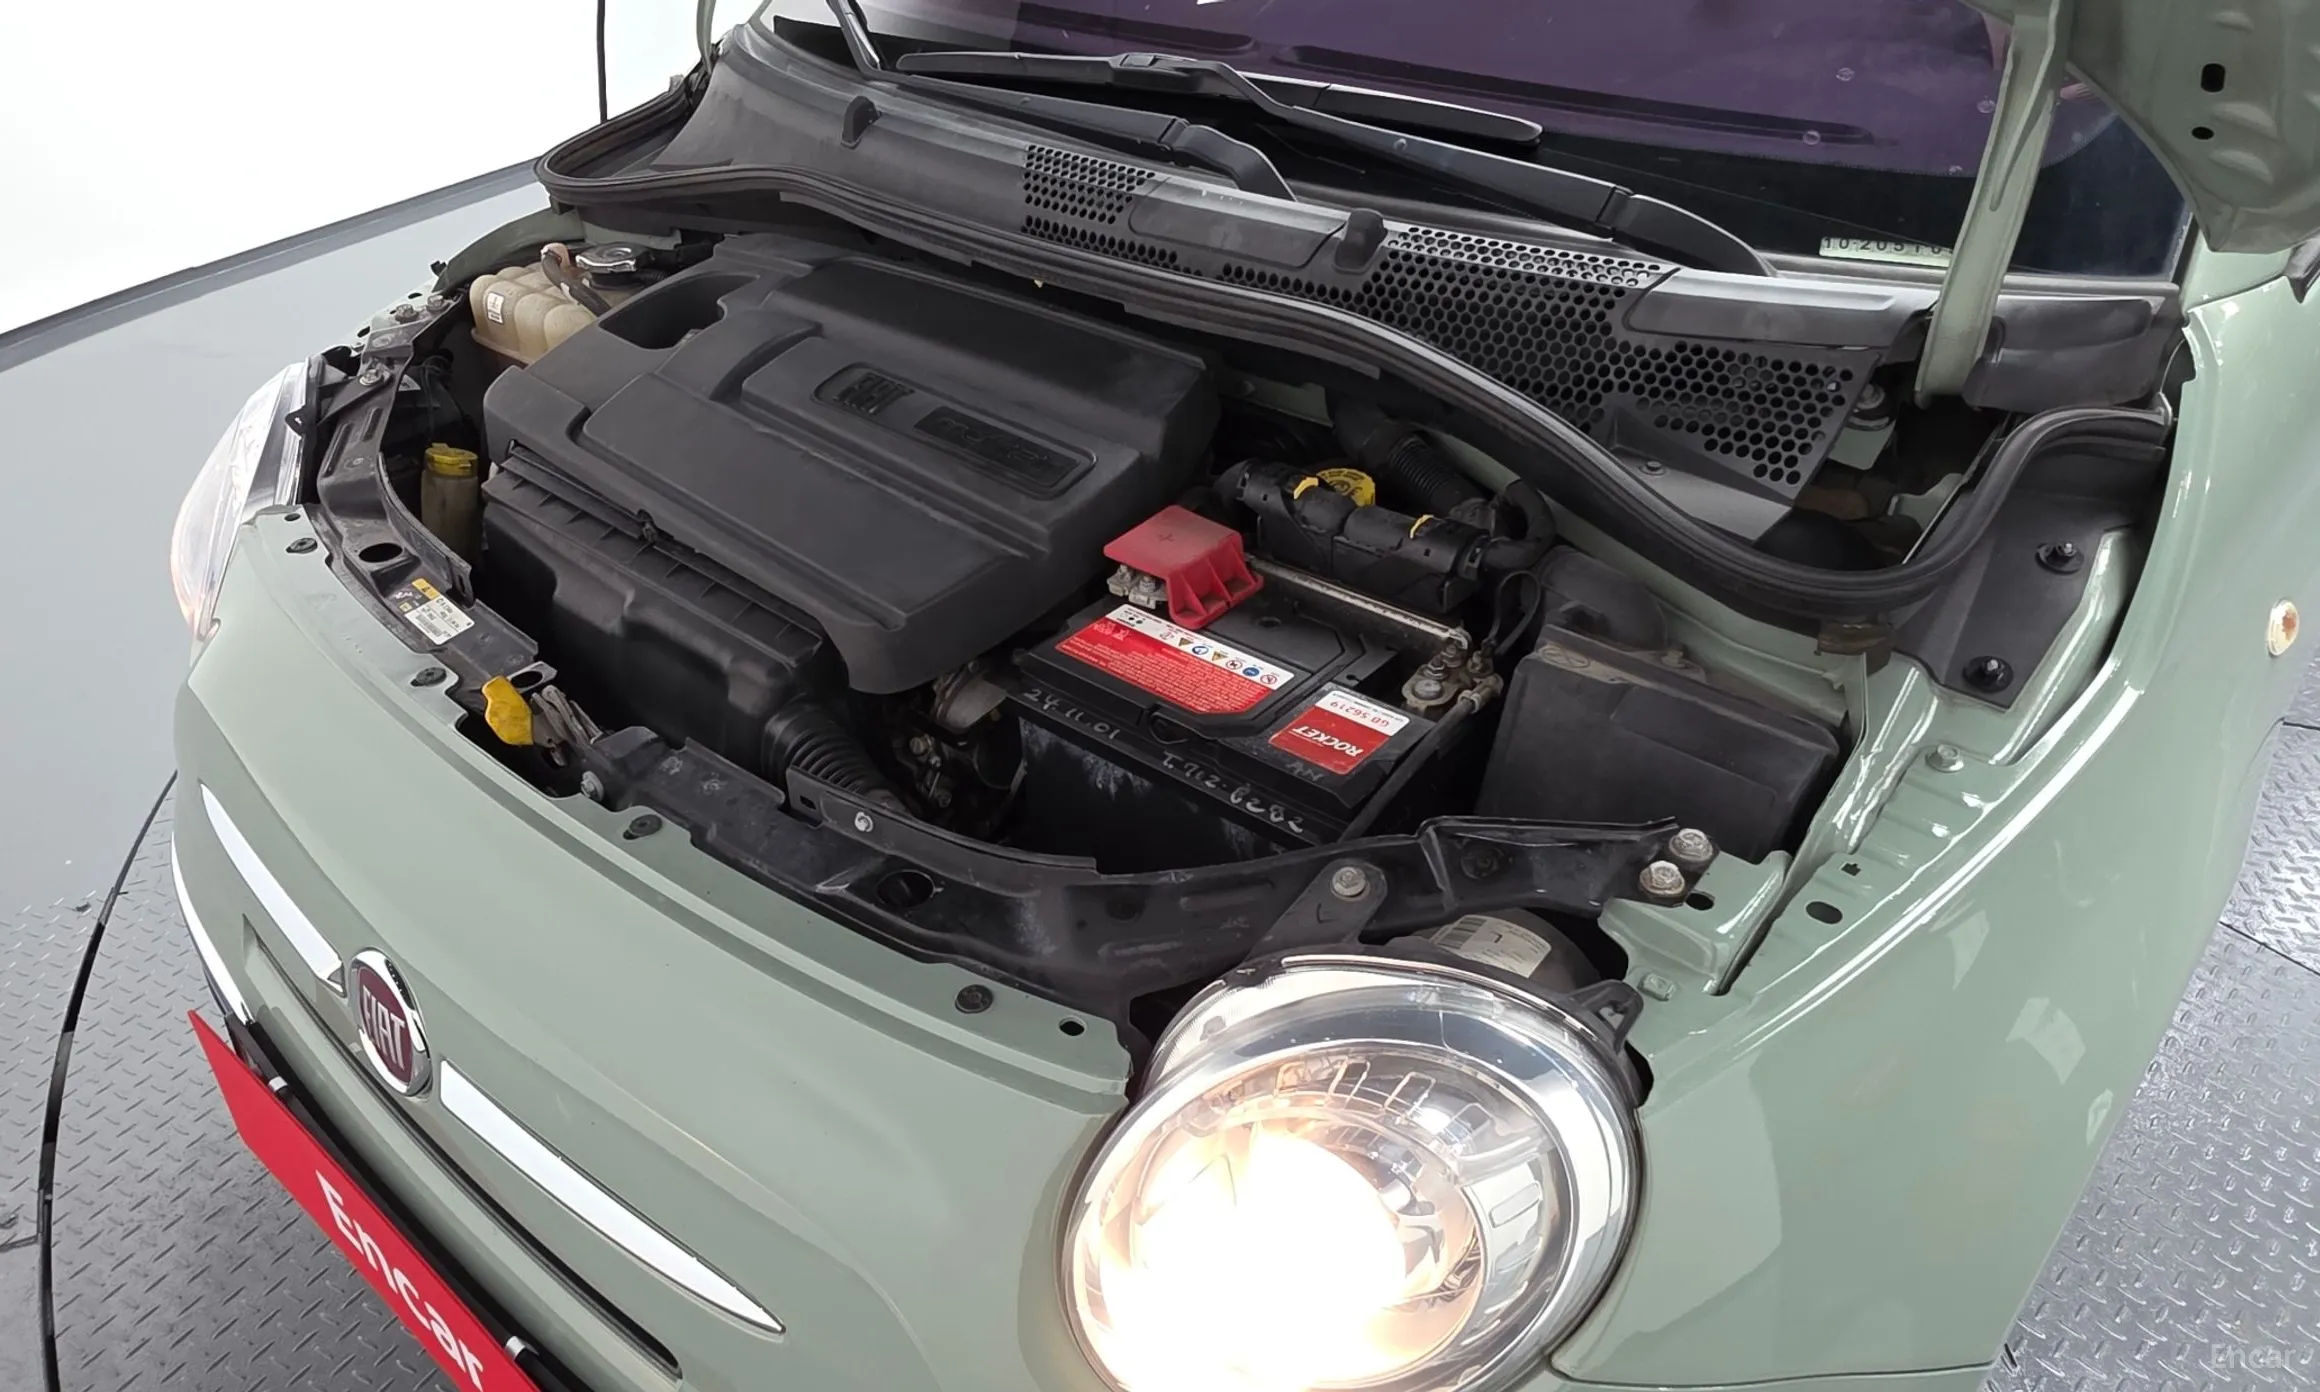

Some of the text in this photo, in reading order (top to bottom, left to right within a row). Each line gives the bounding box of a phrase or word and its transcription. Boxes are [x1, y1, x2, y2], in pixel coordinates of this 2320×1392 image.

[1330, 701, 1369, 719] 56219
[1291, 726, 1364, 757] ROCKET
[363, 984, 406, 1071] FIAT
[315, 1169, 484, 1392] Encar
